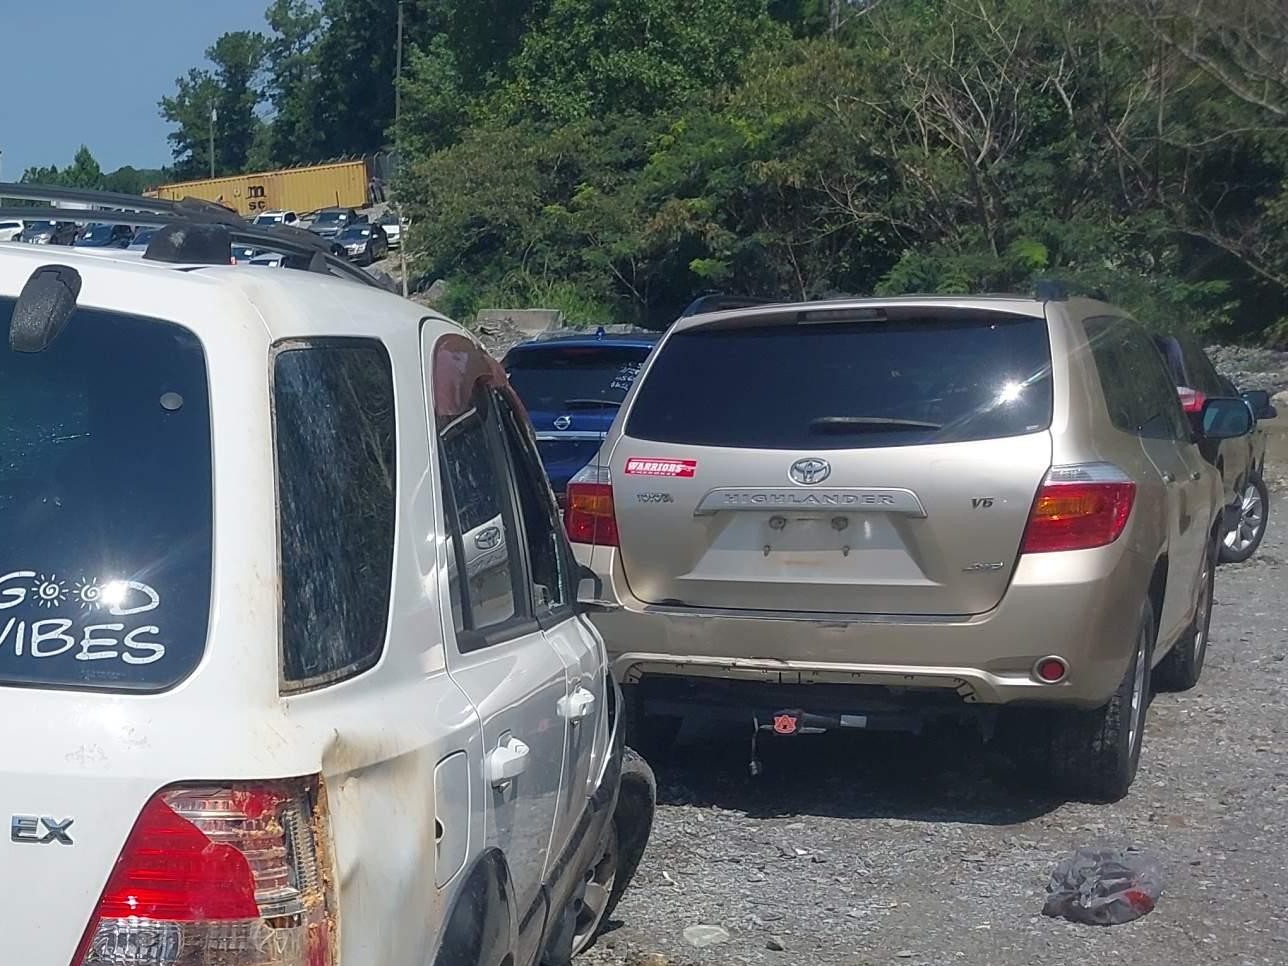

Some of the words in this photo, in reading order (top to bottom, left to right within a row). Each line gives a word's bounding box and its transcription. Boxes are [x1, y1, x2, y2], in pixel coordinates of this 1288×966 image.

[627, 461, 683, 473] WARRIORS
[723, 493, 896, 505] HIGHLANDER
[971, 497, 993, 510] V6
[10, 814, 75, 846] EX
